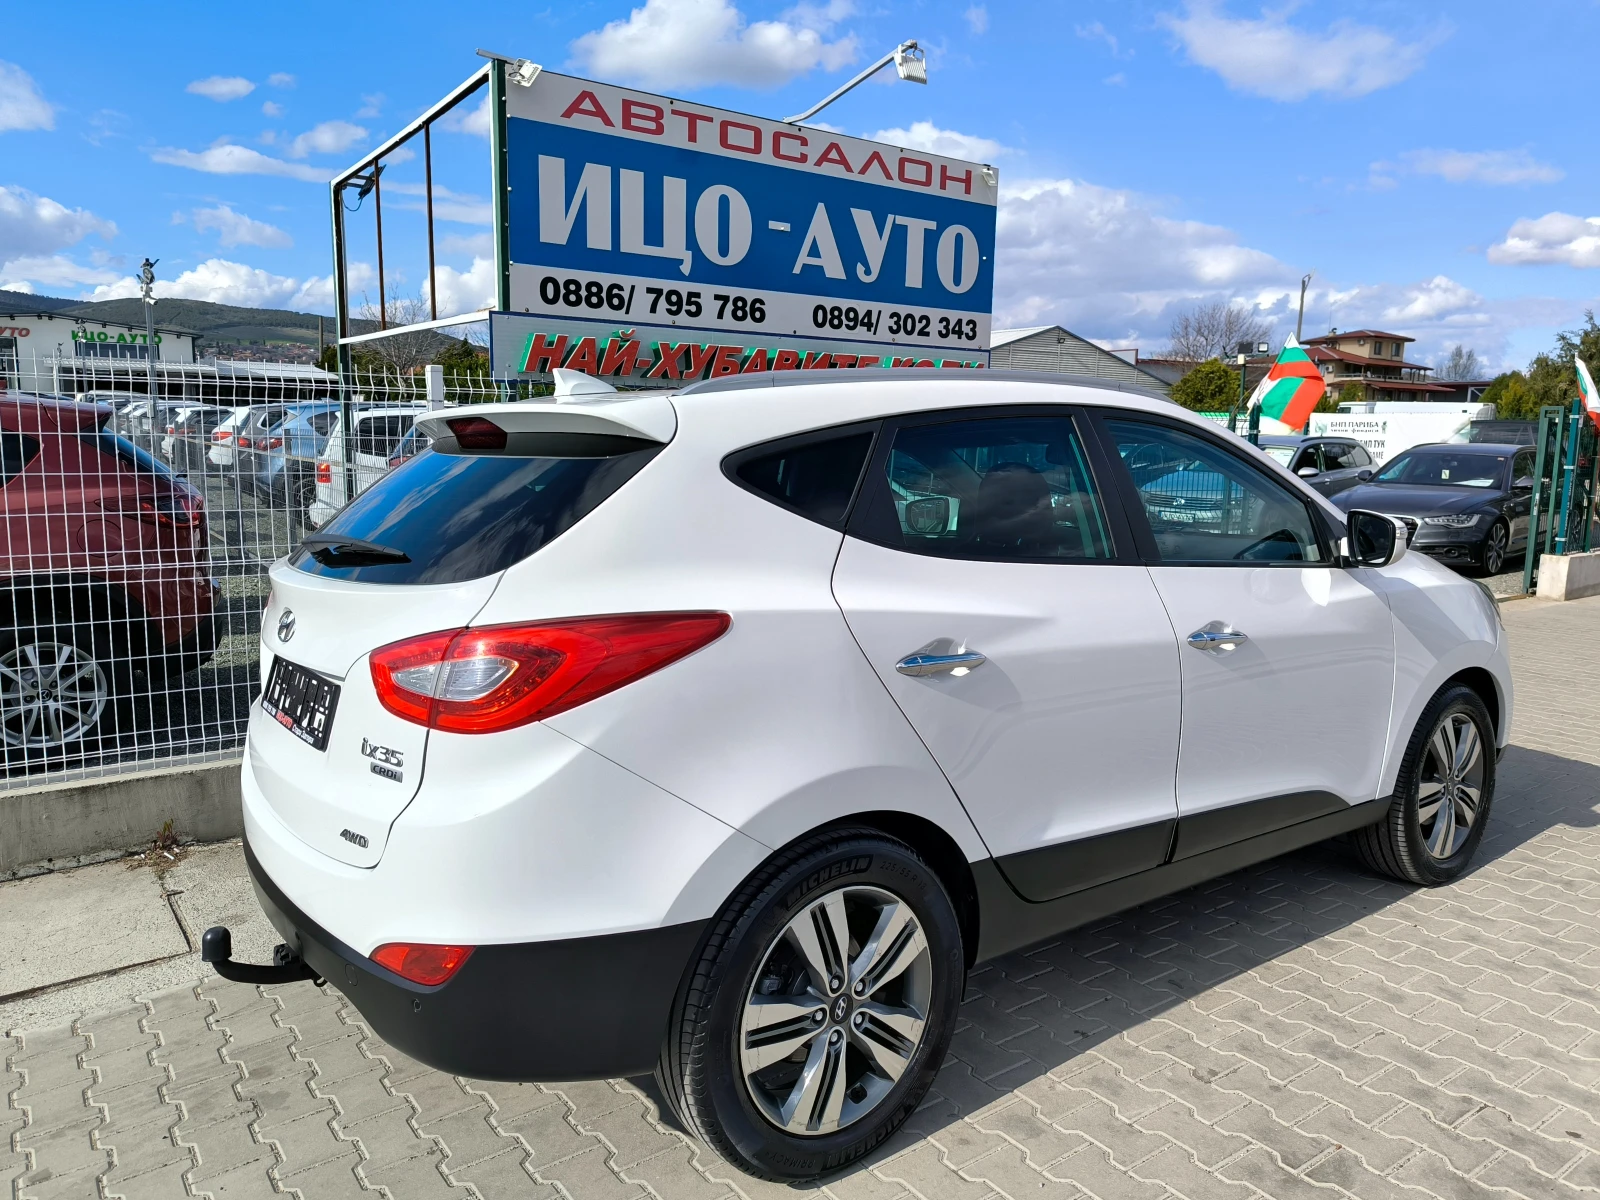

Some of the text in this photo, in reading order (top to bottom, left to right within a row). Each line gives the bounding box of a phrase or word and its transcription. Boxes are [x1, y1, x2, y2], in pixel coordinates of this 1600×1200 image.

[560, 90, 973, 195] АВТОСАЛОН
[539, 276, 767, 324] 0886/ 795 786
[812, 304, 978, 341] 0894/ 302 343
[361, 737, 404, 768] ix35
[372, 765, 398, 780] CRDi
[786, 856, 872, 906] MICHELIN
